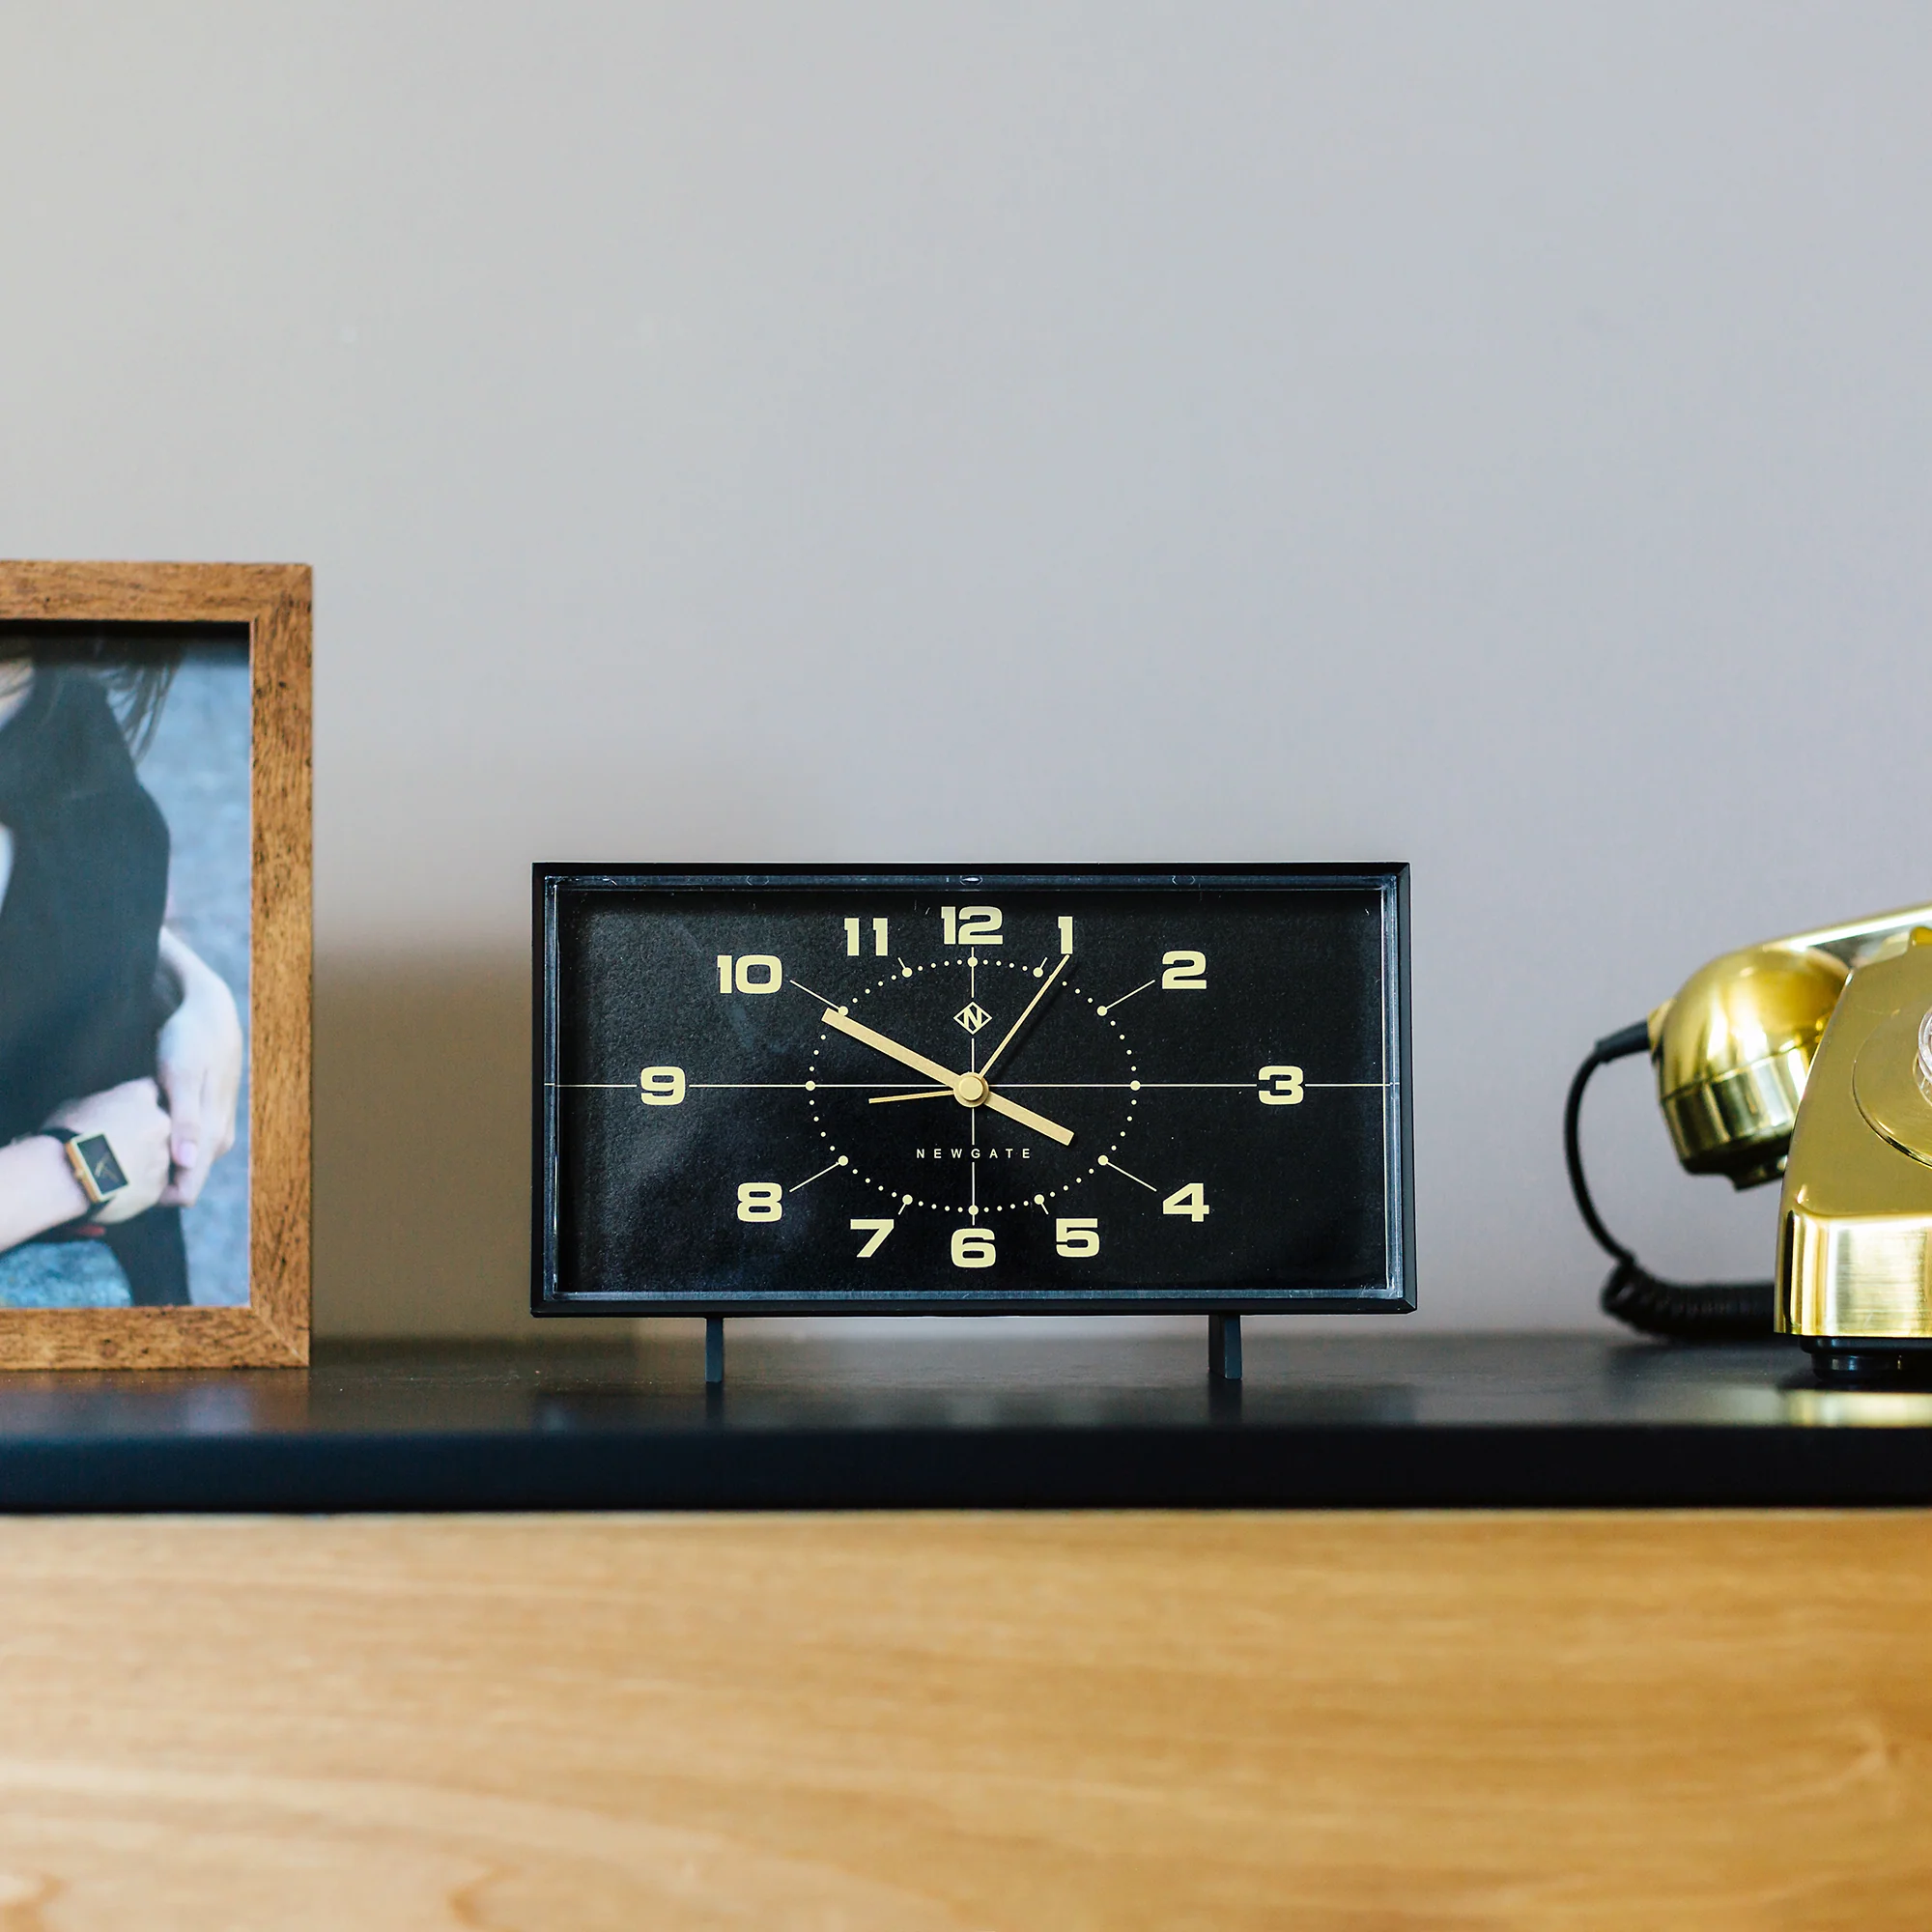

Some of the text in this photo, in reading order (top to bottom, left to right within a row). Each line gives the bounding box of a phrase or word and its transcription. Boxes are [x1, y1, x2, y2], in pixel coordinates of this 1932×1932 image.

[844, 918, 888, 955] 11
[941, 906, 1003, 944] 12
[1058, 917, 1072, 952] 1
[717, 954, 782, 994] 10
[1162, 951, 1207, 989] 2
[963, 1005, 983, 1031] N
[640, 1066, 686, 1105] 9
[1259, 1065, 1303, 1104] 3
[916, 1148, 1031, 1159] NEWGATE
[737, 1182, 782, 1222] 8
[1163, 1183, 1209, 1222] 4
[850, 1219, 894, 1257] 7
[952, 1229, 996, 1267] 6
[1056, 1218, 1099, 1257] 5
